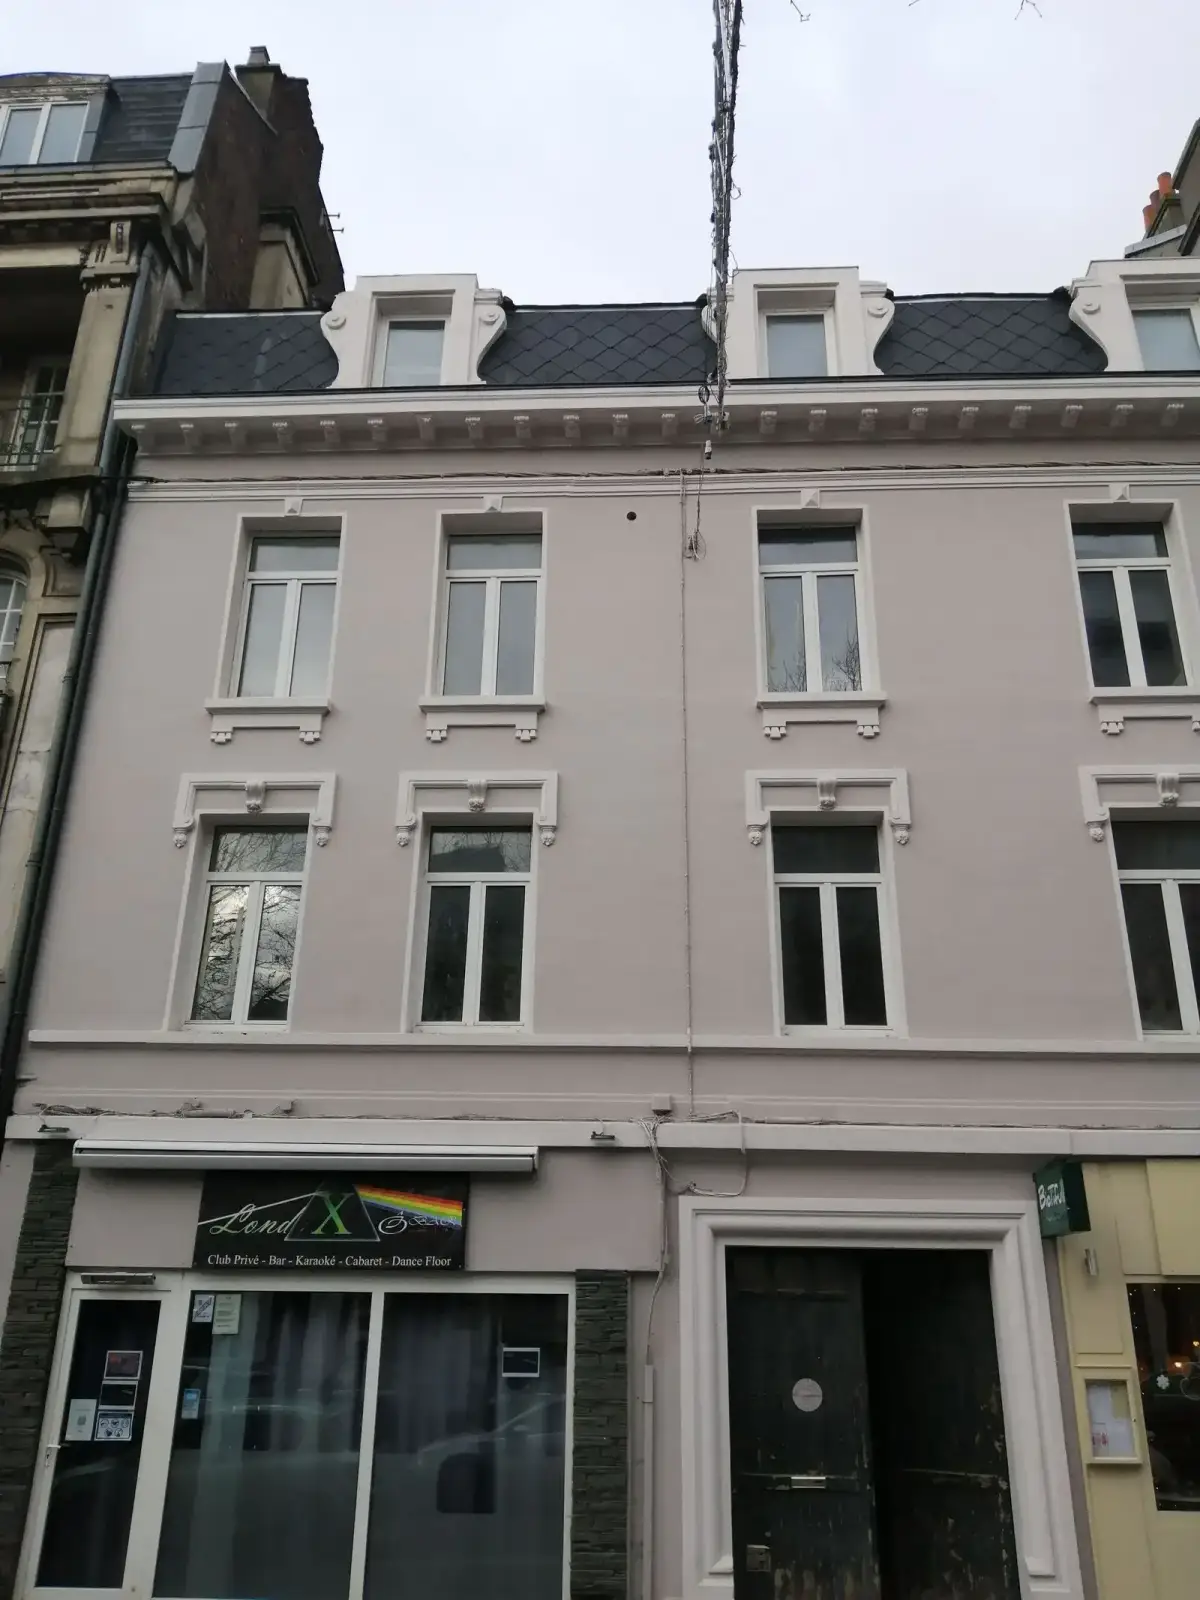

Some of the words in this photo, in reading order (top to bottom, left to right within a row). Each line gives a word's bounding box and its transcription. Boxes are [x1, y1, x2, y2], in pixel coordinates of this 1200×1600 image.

[207, 1254, 231, 1265] Club
[234, 1254, 259, 1265] Privé
[269, 1255, 287, 1266] Bar
[295, 1255, 336, 1266] Karaoké
[345, 1255, 382, 1266] Cabaret
[392, 1255, 422, 1266] Dance
[425, 1256, 452, 1266] Floor
